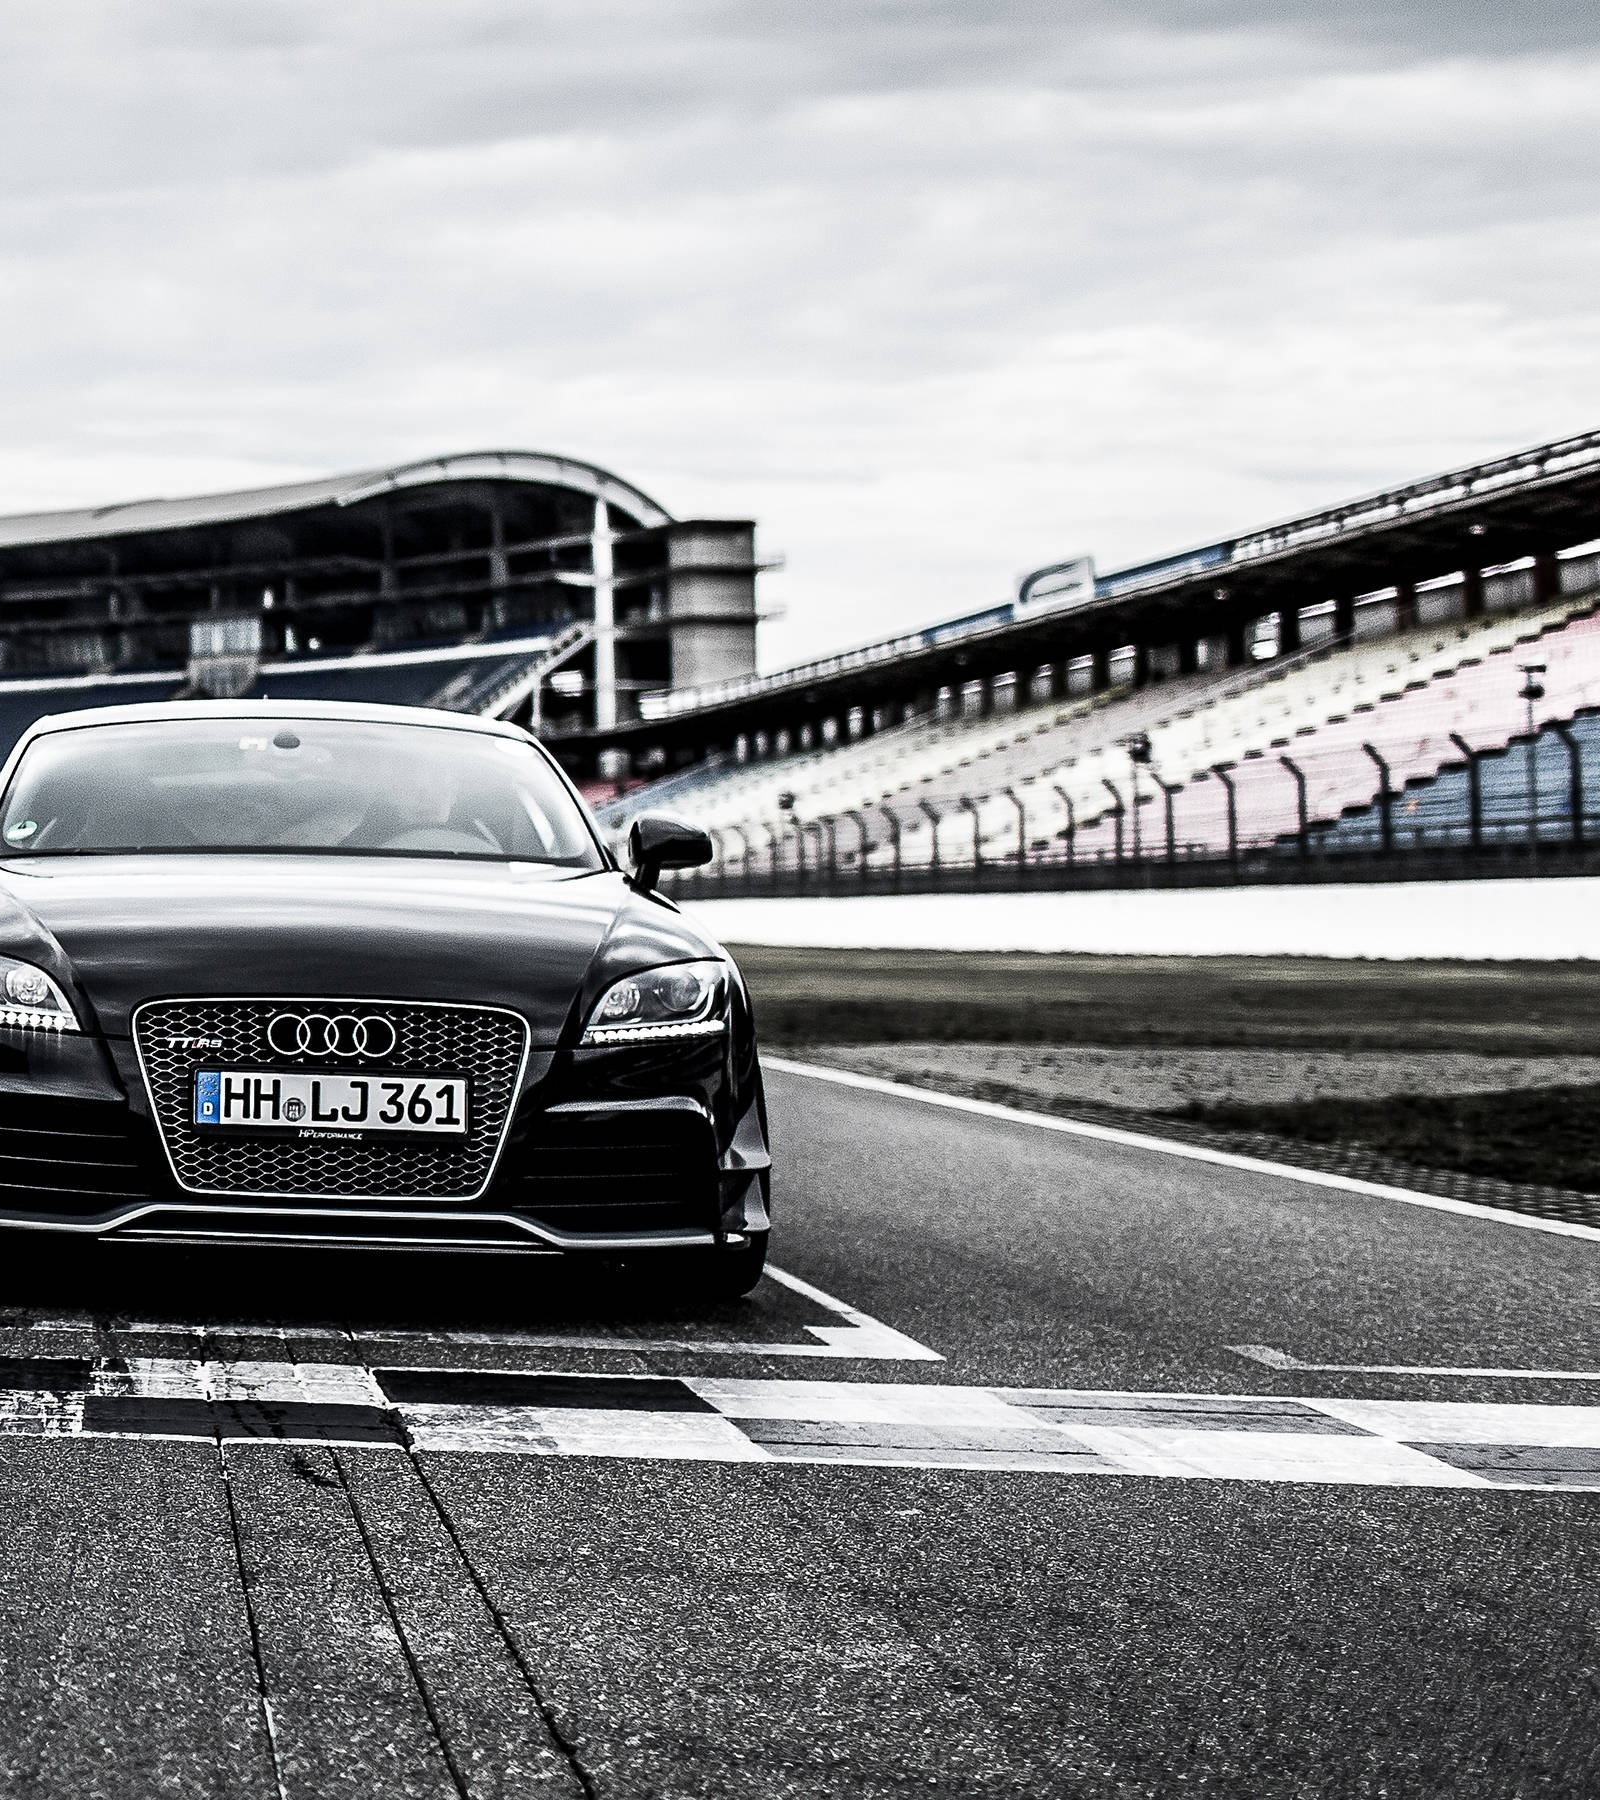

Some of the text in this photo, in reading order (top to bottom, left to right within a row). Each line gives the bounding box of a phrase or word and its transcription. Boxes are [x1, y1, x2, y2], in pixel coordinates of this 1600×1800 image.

[203, 1102, 214, 1115] D
[224, 1078, 460, 1125] HH LJ 361
